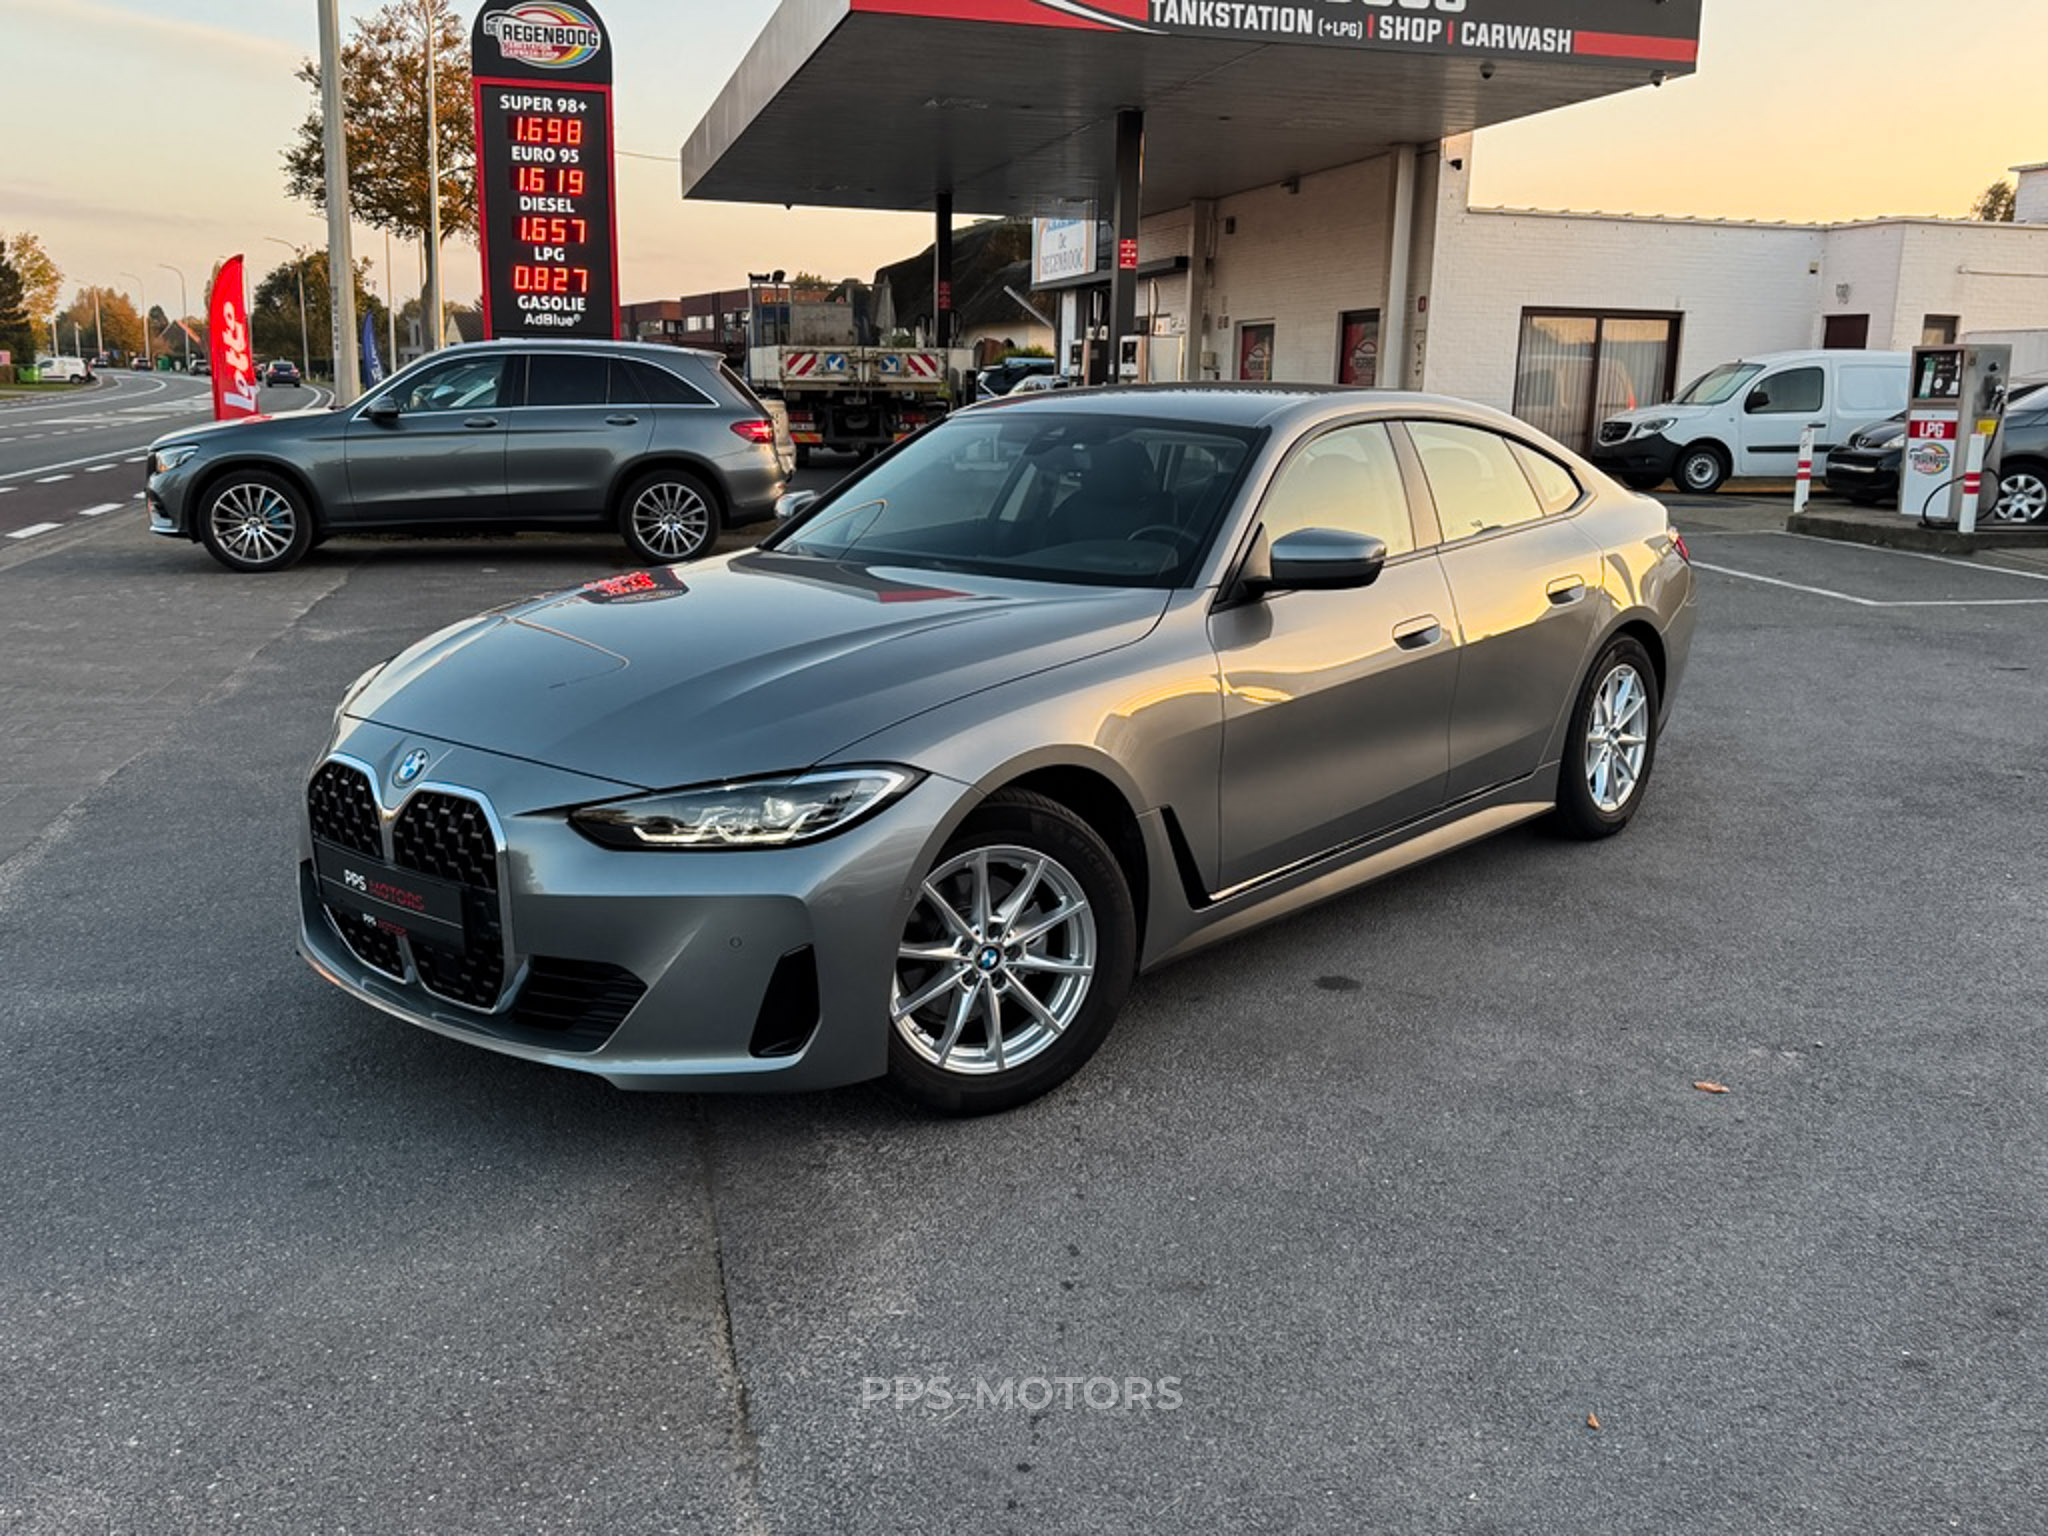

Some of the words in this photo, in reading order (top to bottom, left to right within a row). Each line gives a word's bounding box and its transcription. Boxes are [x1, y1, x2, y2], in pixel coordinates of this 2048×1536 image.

[503, 23, 598, 46] REGENBOOG
[1153, 0, 1313, 34] TANKSTATION
[1317, 17, 1363, 39] (+LPG)
[1379, 15, 1442, 43] SHOP
[1461, 21, 1572, 54] CARWASH
[500, 94, 553, 112] SUPER
[557, 98, 588, 113] 98+
[511, 145, 556, 162] EURO
[559, 149, 580, 163] 95
[519, 196, 575, 213] DIESEL
[534, 246, 565, 262] LPG
[517, 295, 586, 311] GASOLIE
[1919, 422, 1945, 438] LPG
[344, 869, 367, 891] PPS
